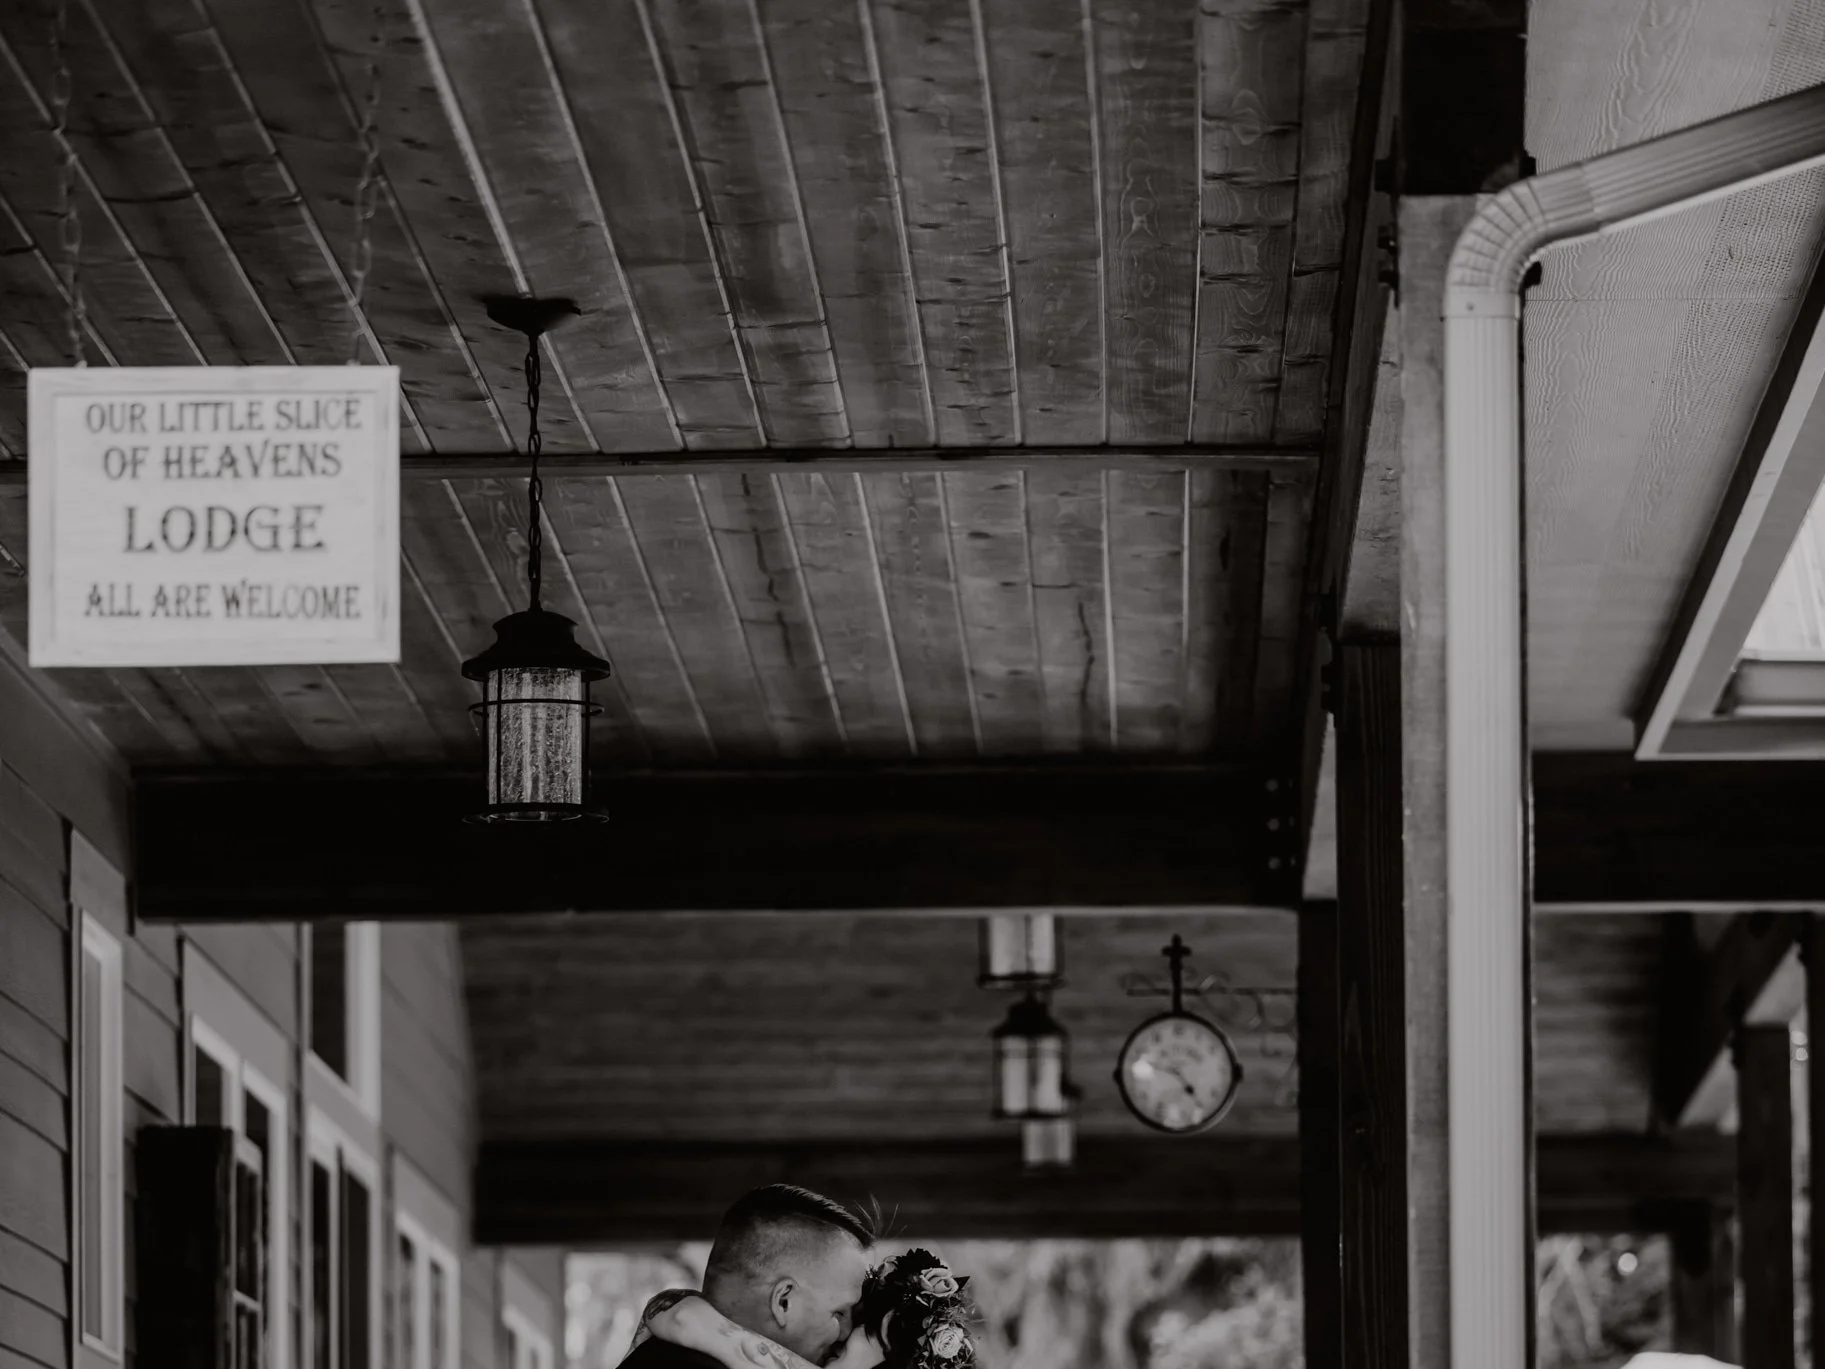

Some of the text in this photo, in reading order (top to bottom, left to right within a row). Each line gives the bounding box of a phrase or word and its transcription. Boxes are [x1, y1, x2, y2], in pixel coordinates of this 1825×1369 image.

[85, 398, 363, 433] OUR LITTLE SLICE
[103, 439, 342, 480] OF HEAVENS
[123, 505, 327, 553] LODGE
[84, 579, 362, 619] ALL ARE WELCOME
